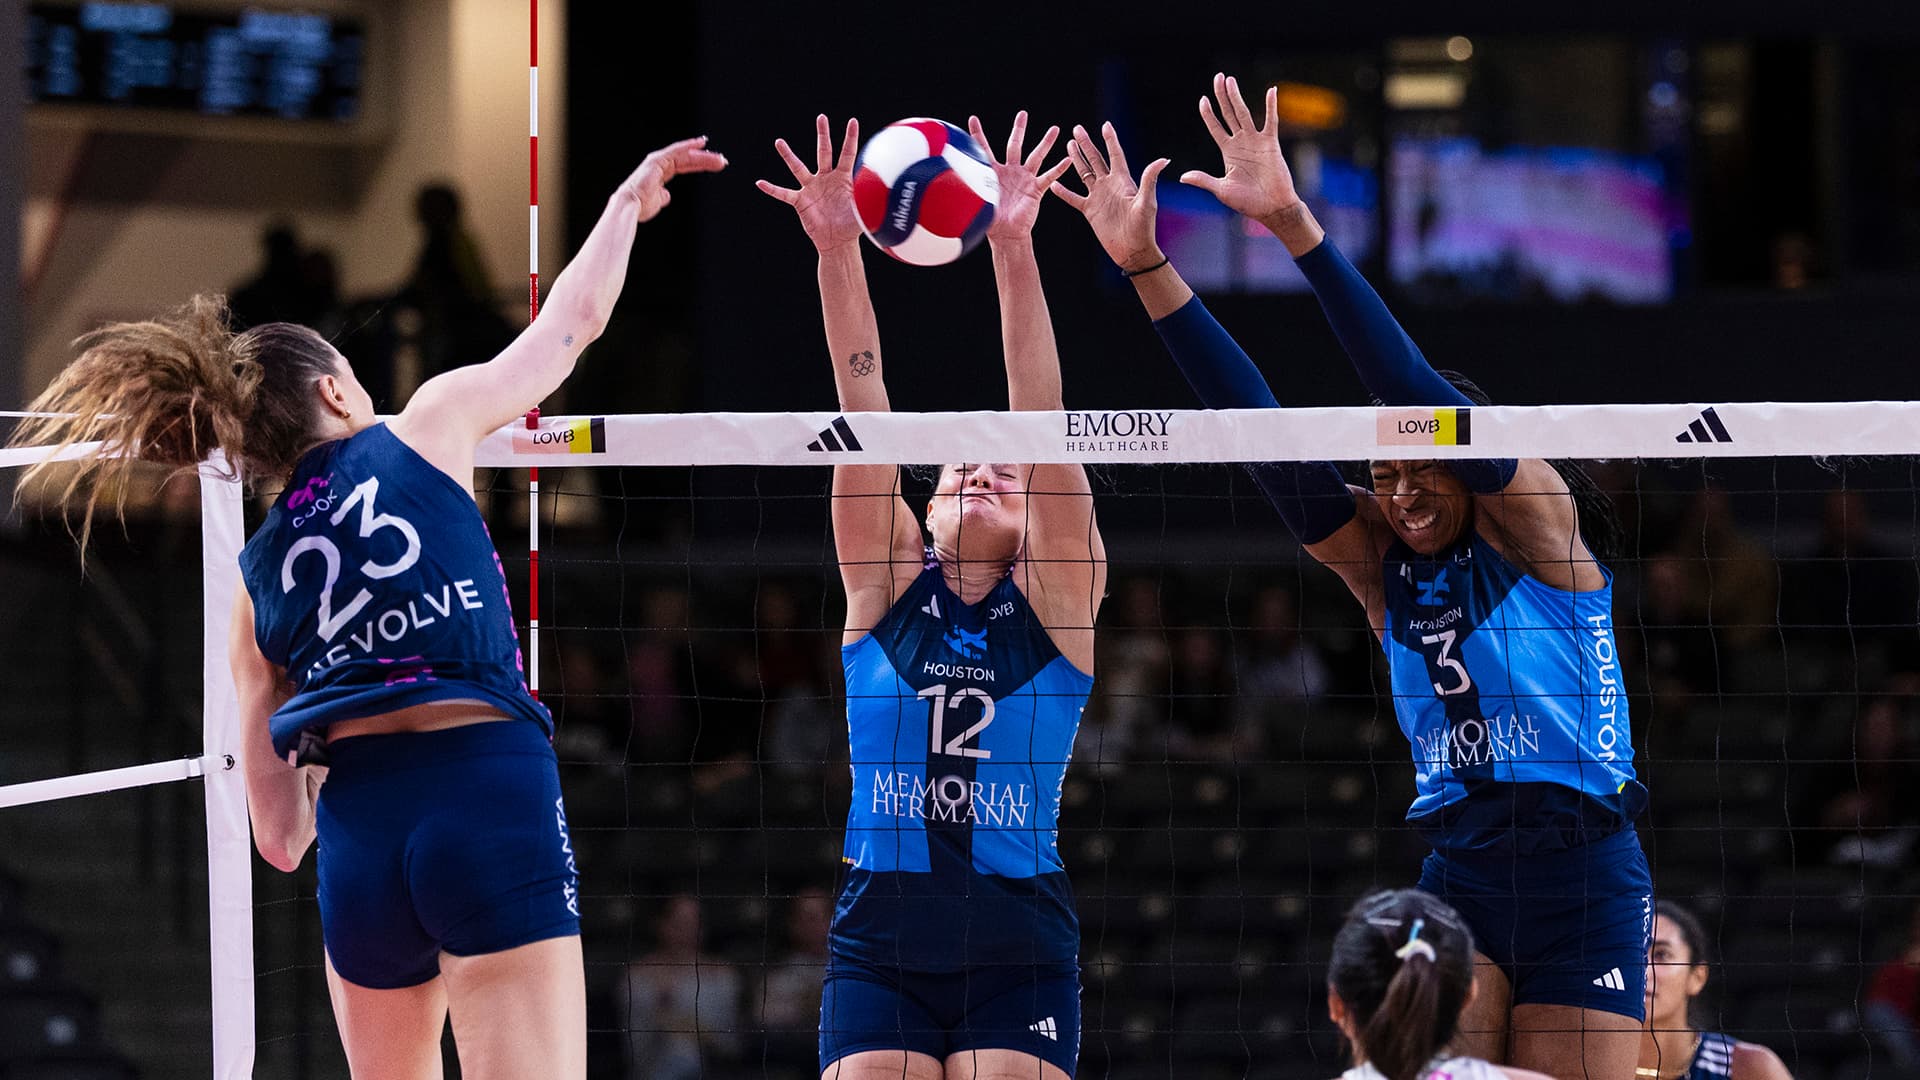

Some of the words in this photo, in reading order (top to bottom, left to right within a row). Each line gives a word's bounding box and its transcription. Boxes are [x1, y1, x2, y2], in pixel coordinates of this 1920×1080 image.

[1065, 412, 1173, 436] EMORY
[1398, 419, 1440, 434] LOVB
[533, 429, 575, 445] LOVB
[1065, 441, 1169, 452] HEALTHCARE
[281, 476, 421, 642] 23
[988, 601, 1015, 620] OVB
[1409, 606, 1463, 630] HOUSTON
[923, 661, 995, 682] HOUSTON
[1420, 629, 1471, 695] 3
[916, 684, 996, 760] 12
[873, 769, 1029, 807] MEMORIAL
[872, 791, 1028, 827] HERMANN
